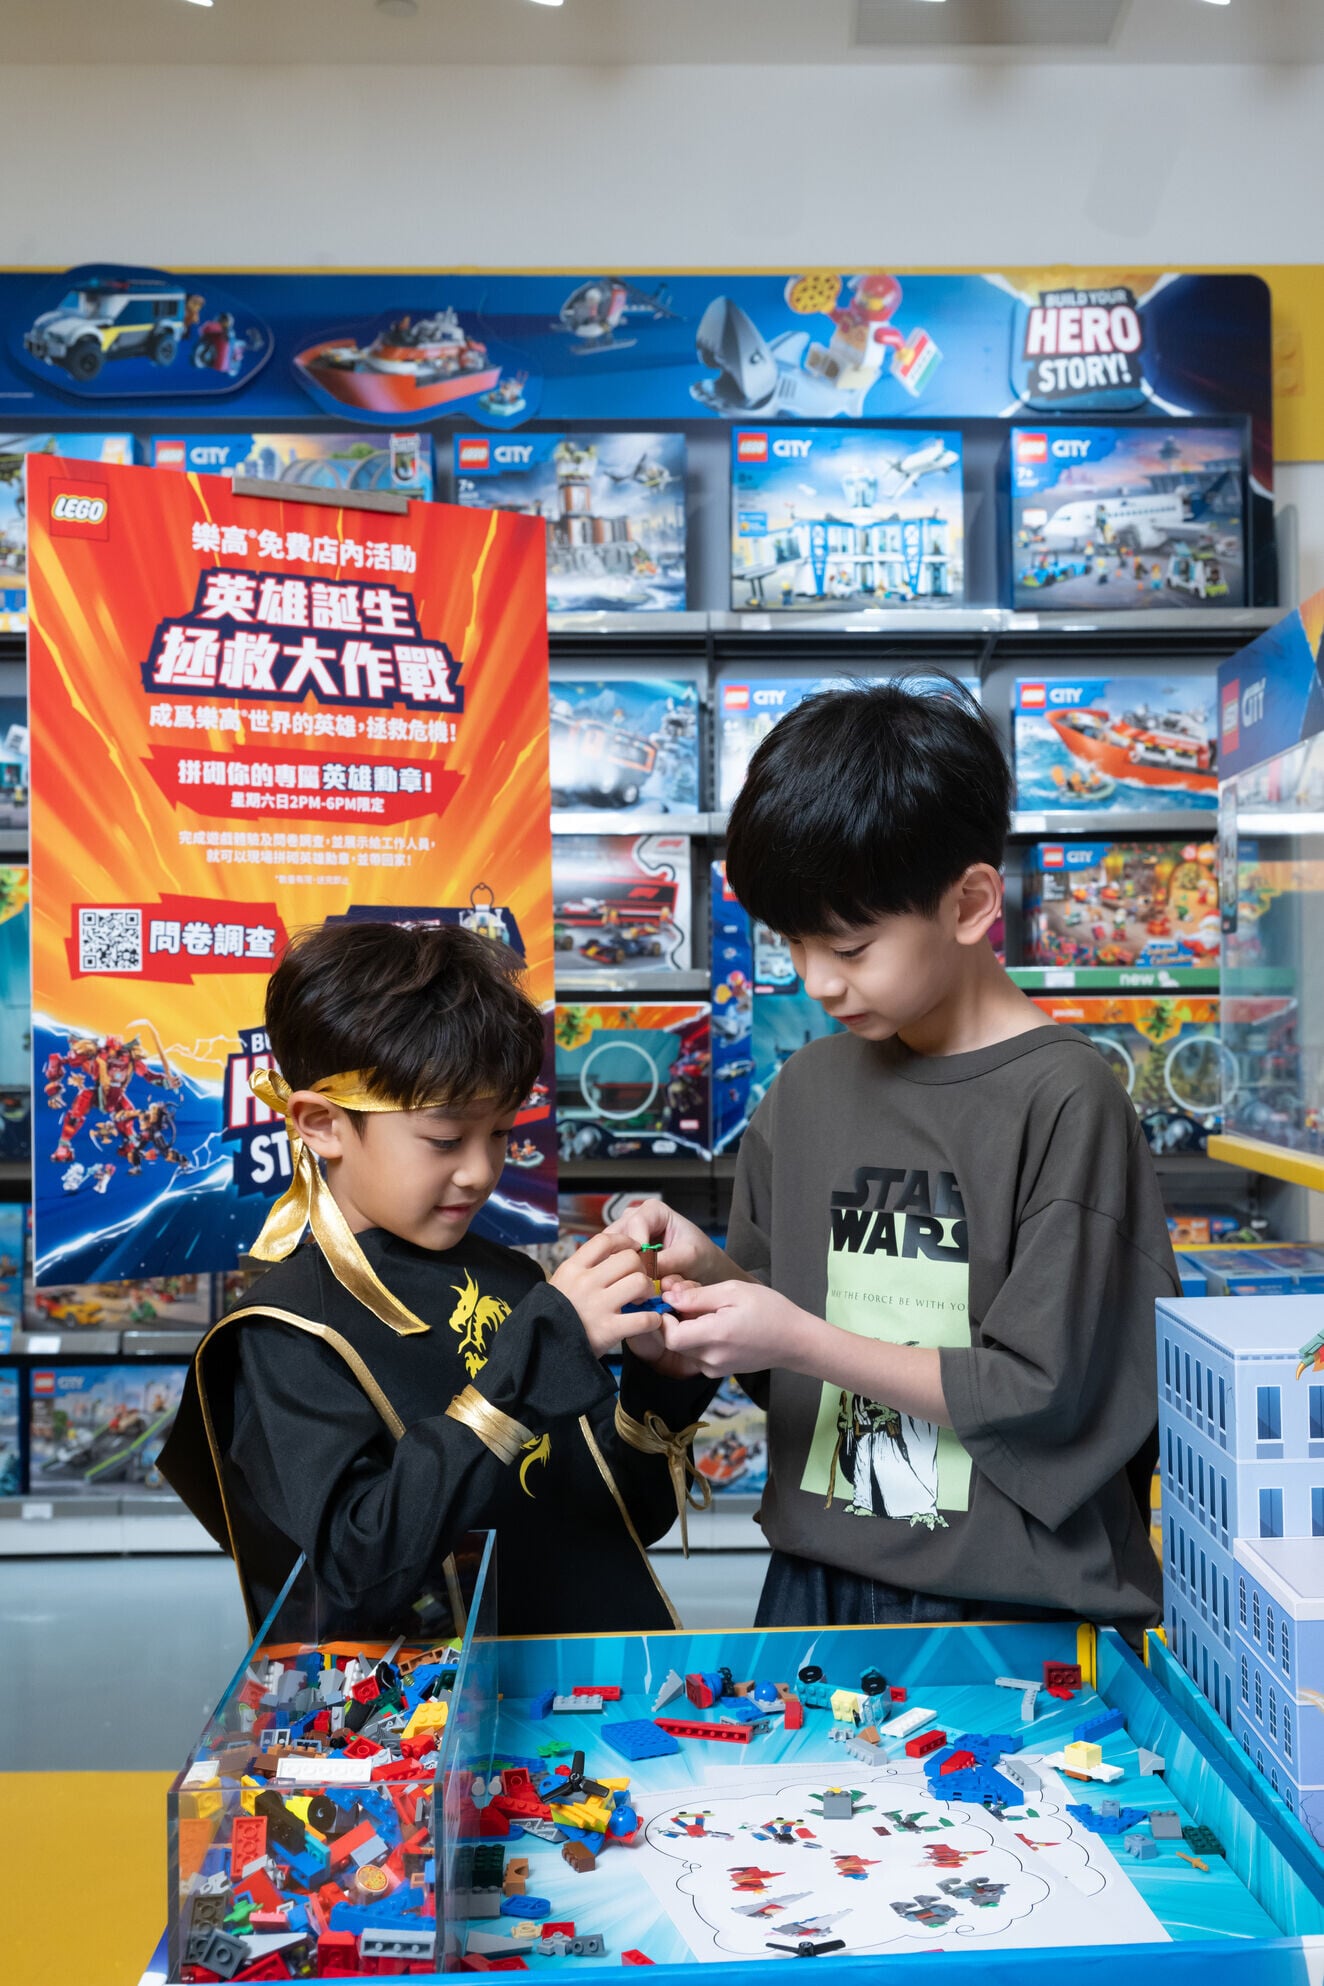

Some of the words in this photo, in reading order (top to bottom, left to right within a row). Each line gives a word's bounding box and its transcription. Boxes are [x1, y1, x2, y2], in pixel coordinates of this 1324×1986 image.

[1045, 292, 1088, 307] BUILD
[1089, 289, 1128, 304] YOUR
[1026, 306, 1141, 354] HERO
[1038, 353, 1132, 392] STORY!
[190, 446, 230, 465] CITY
[494, 445, 533, 463] CITY
[773, 439, 813, 457] CITY
[1052, 439, 1092, 458] CITY
[53, 495, 106, 522] LEGO
[197, 573, 416, 637] 英雄誕生
[153, 625, 456, 703] 拯救大作戰
[753, 690, 787, 705] CITY
[1049, 688, 1084, 704] CITY
[149, 919, 276, 958] 問卷調查
[1119, 973, 1155, 986] new
[843, 1290, 859, 1300] THE
[863, 1293, 893, 1304] FORCE
[898, 1296, 910, 1306] BE
[915, 1298, 945, 1310] WITH
[950, 1302, 967, 1311] YO
